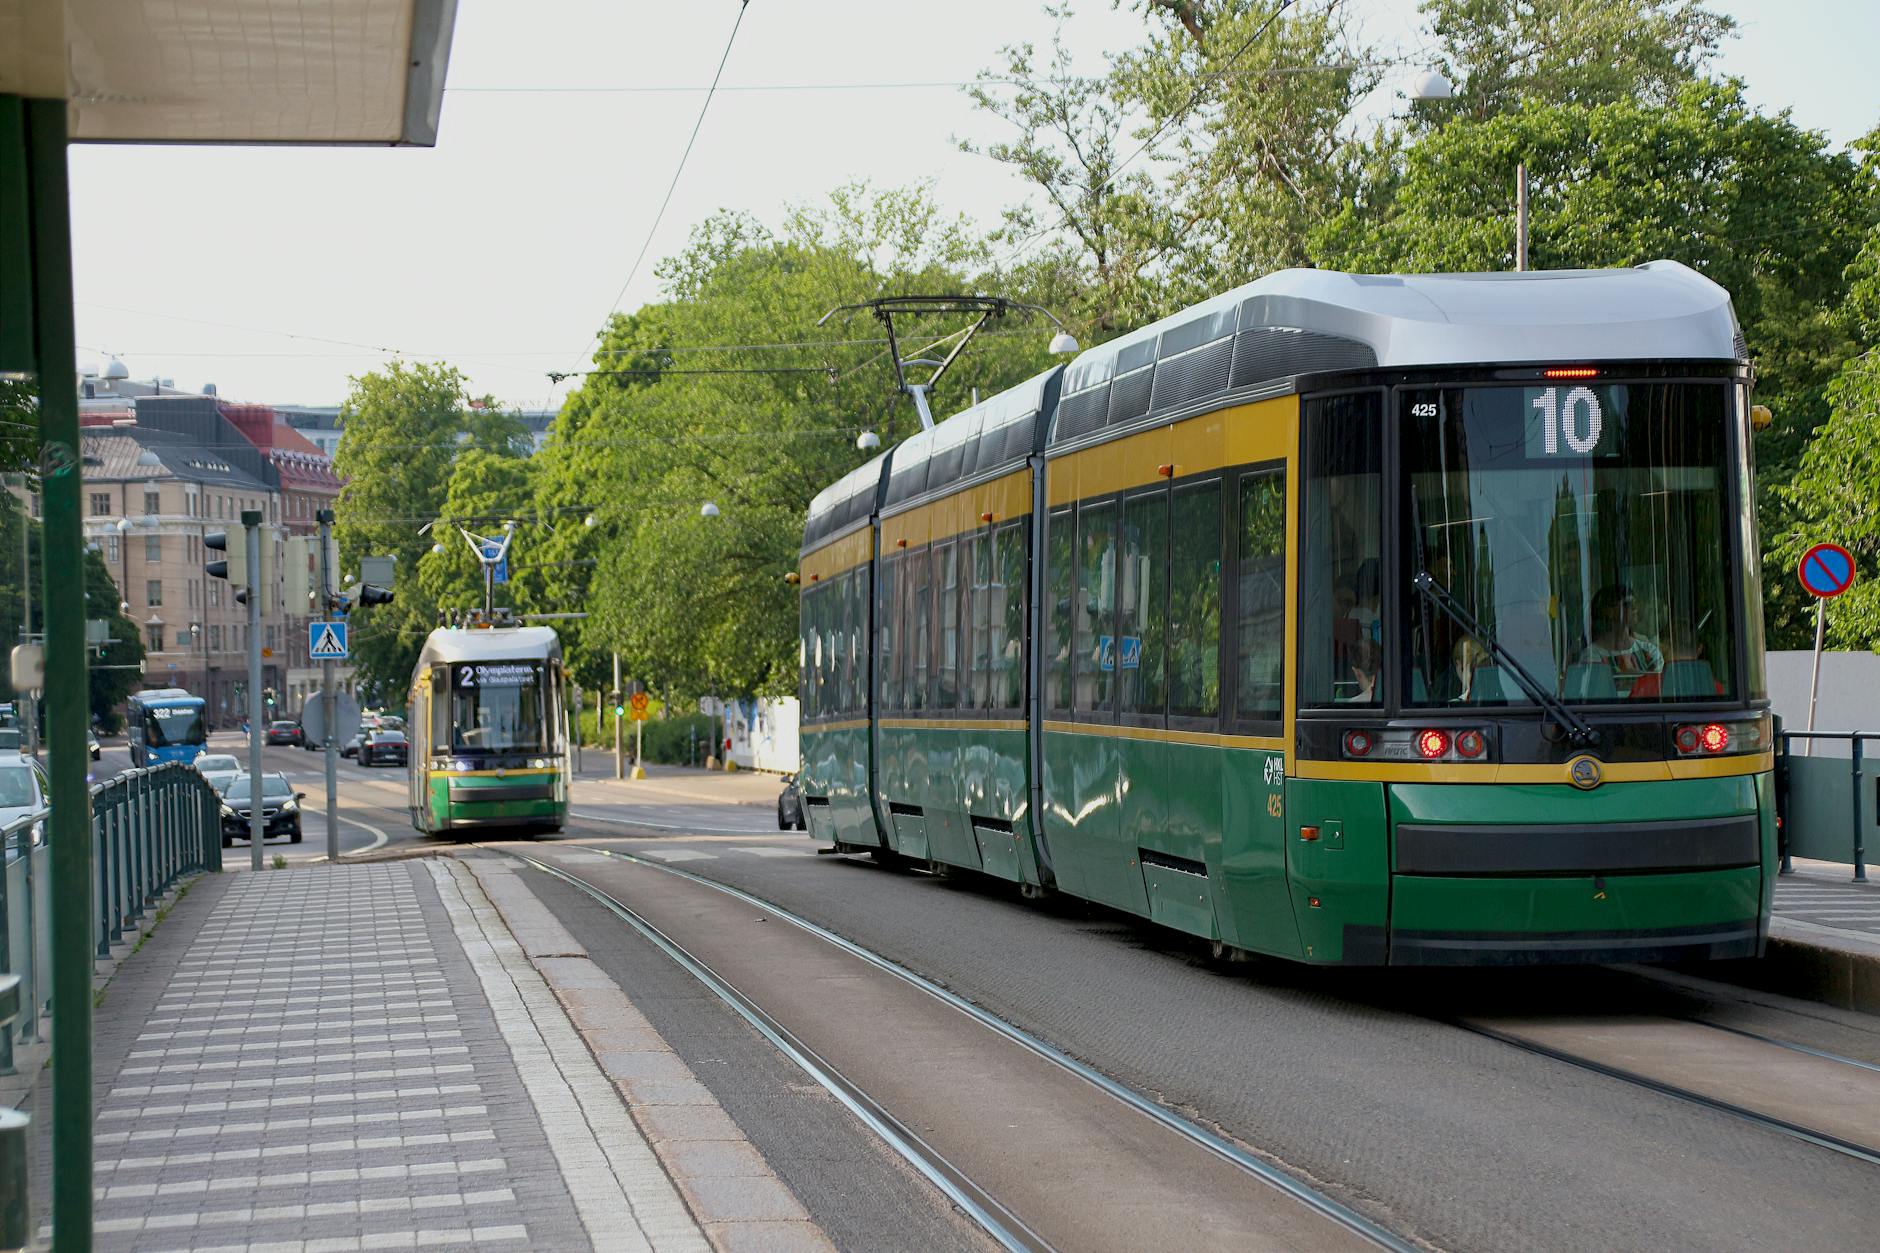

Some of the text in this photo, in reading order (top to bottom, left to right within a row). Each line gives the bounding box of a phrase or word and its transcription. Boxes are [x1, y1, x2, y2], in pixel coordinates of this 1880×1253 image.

[1411, 403, 1437, 417] 425
[1532, 386, 1602, 454] 10
[460, 665, 475, 687] 2
[153, 707, 172, 719] 322
[1273, 757, 1284, 771] HKL
[1273, 771, 1284, 785] HST
[1267, 794, 1282, 817] 425
